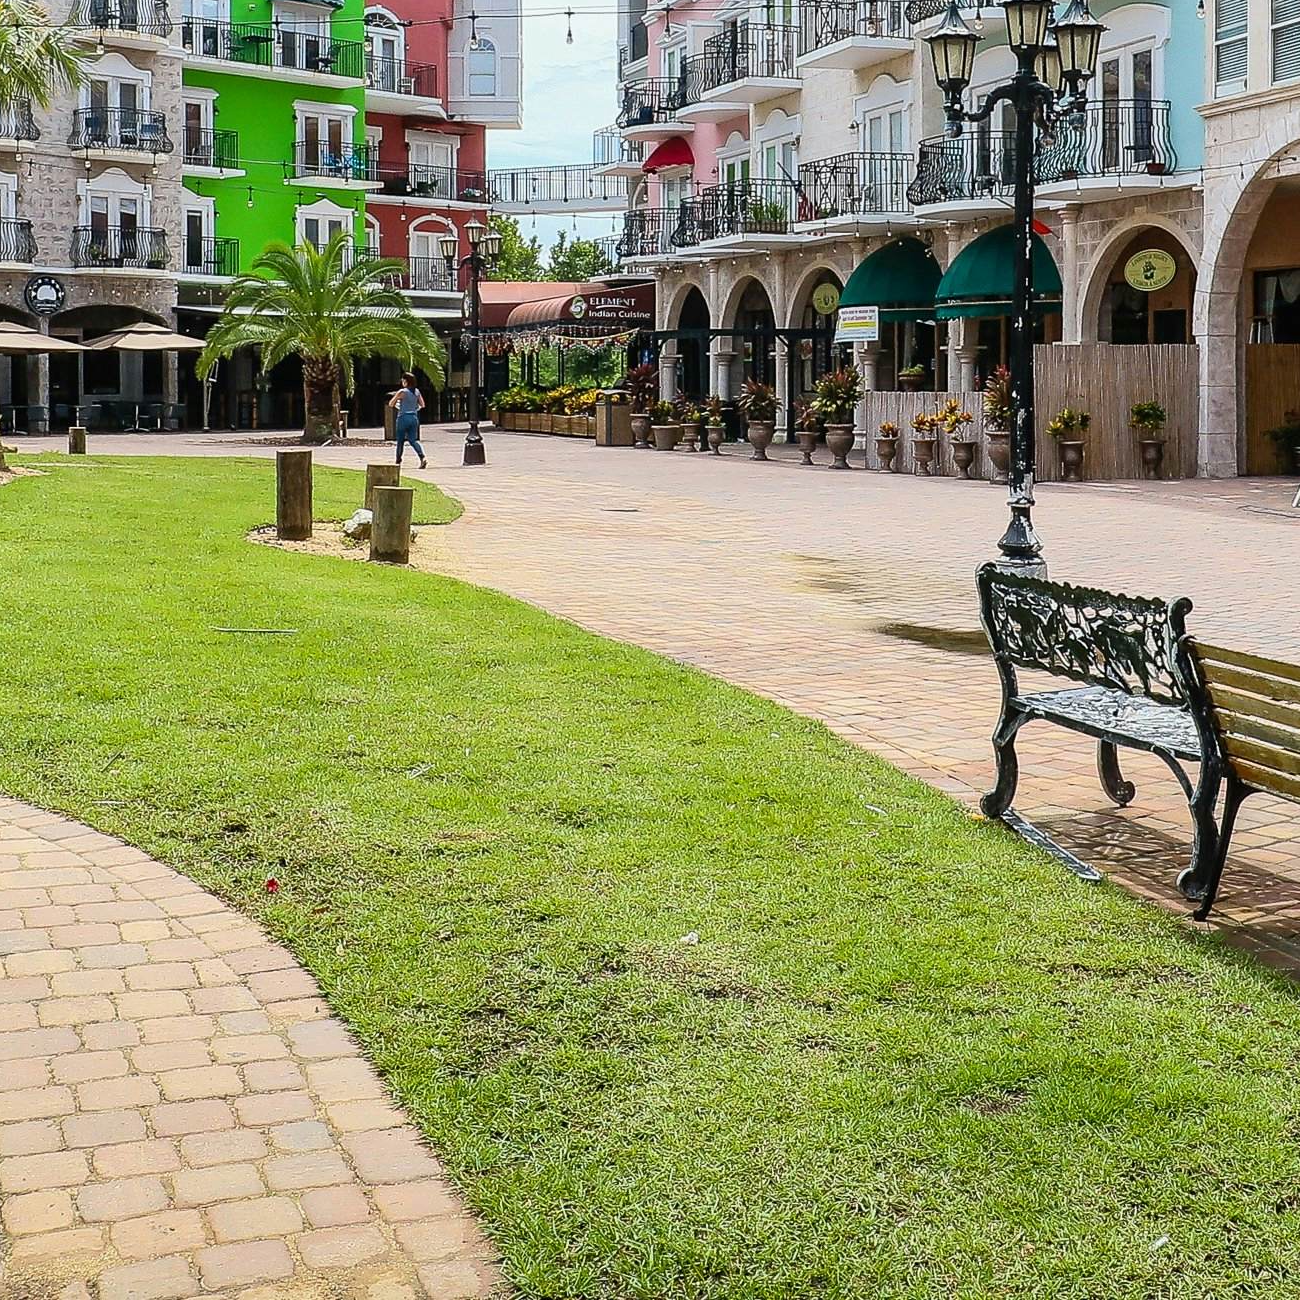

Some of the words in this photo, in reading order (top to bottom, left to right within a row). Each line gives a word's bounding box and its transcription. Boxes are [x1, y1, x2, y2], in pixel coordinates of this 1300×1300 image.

[589, 297, 637, 306] ELEMENT
[588, 310, 617, 318] Indian
[618, 311, 651, 319] Cuisine
